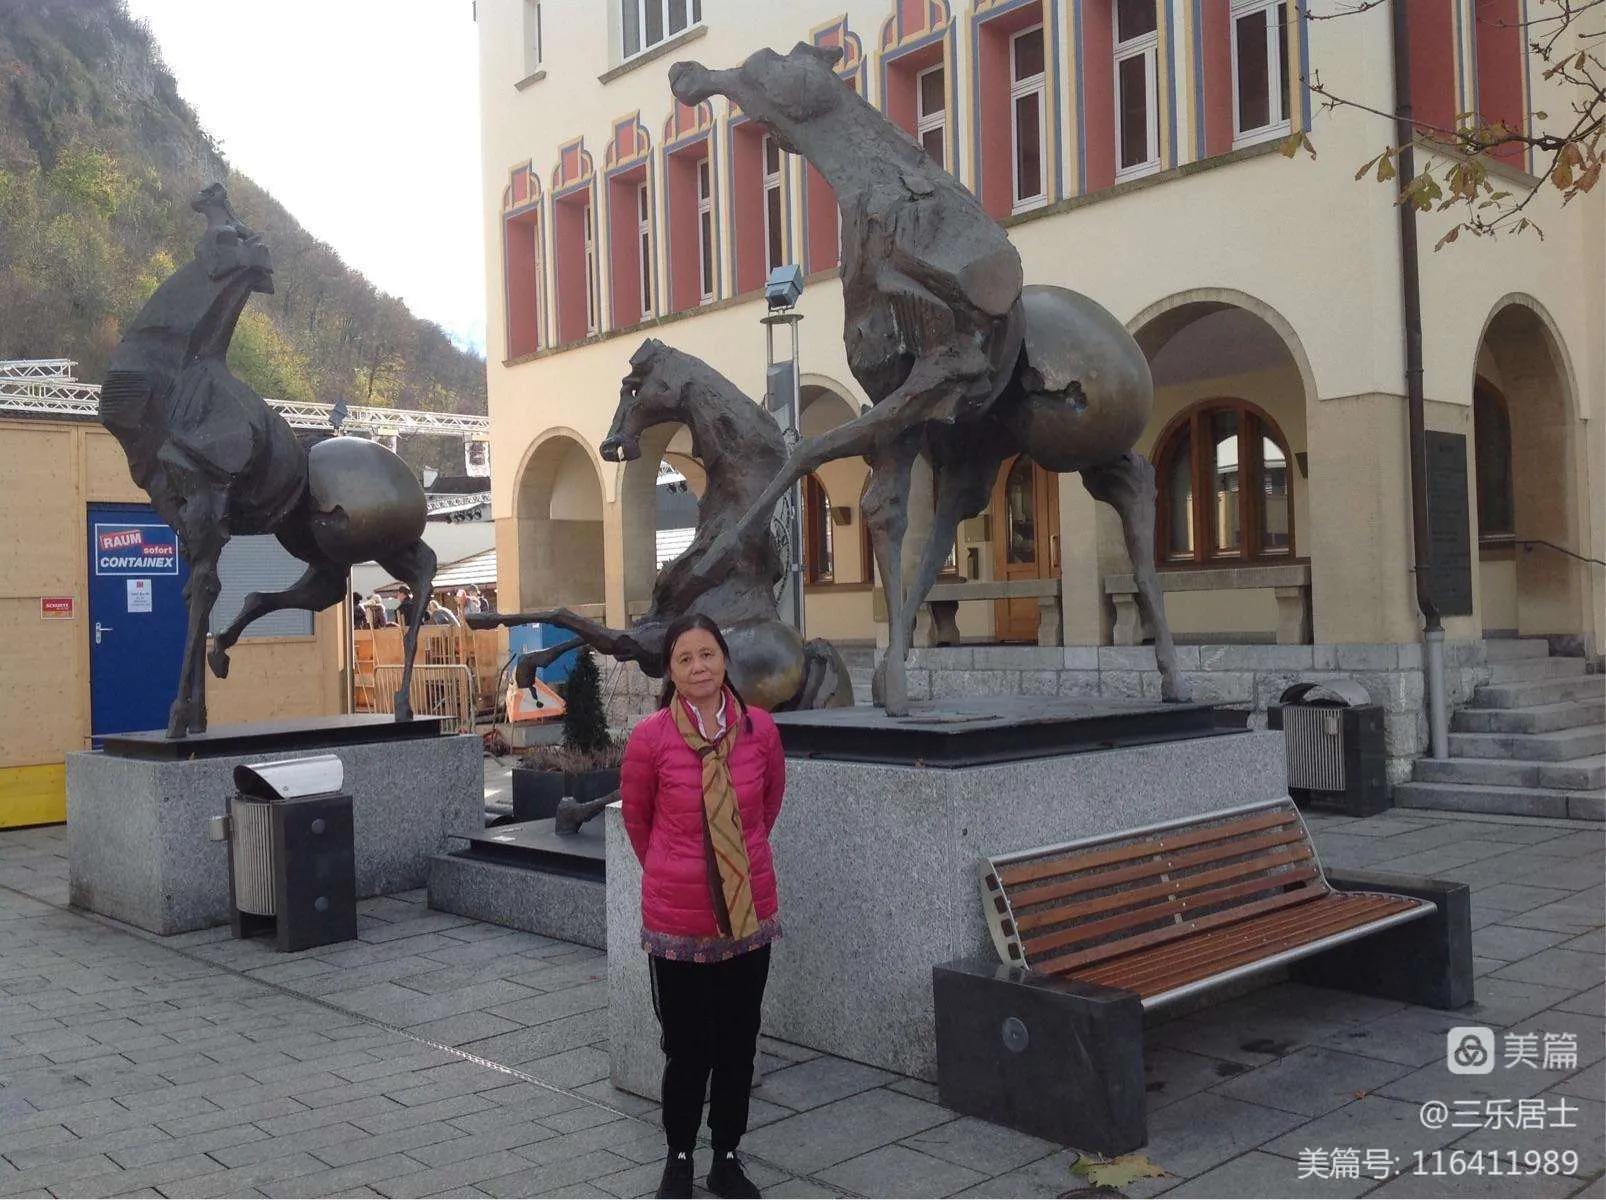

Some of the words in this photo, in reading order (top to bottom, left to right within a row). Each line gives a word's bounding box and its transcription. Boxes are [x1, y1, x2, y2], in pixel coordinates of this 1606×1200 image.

[103, 532, 142, 549] RAUM
[143, 546, 173, 554] sofort
[100, 557, 173, 568] CONTAINEX
